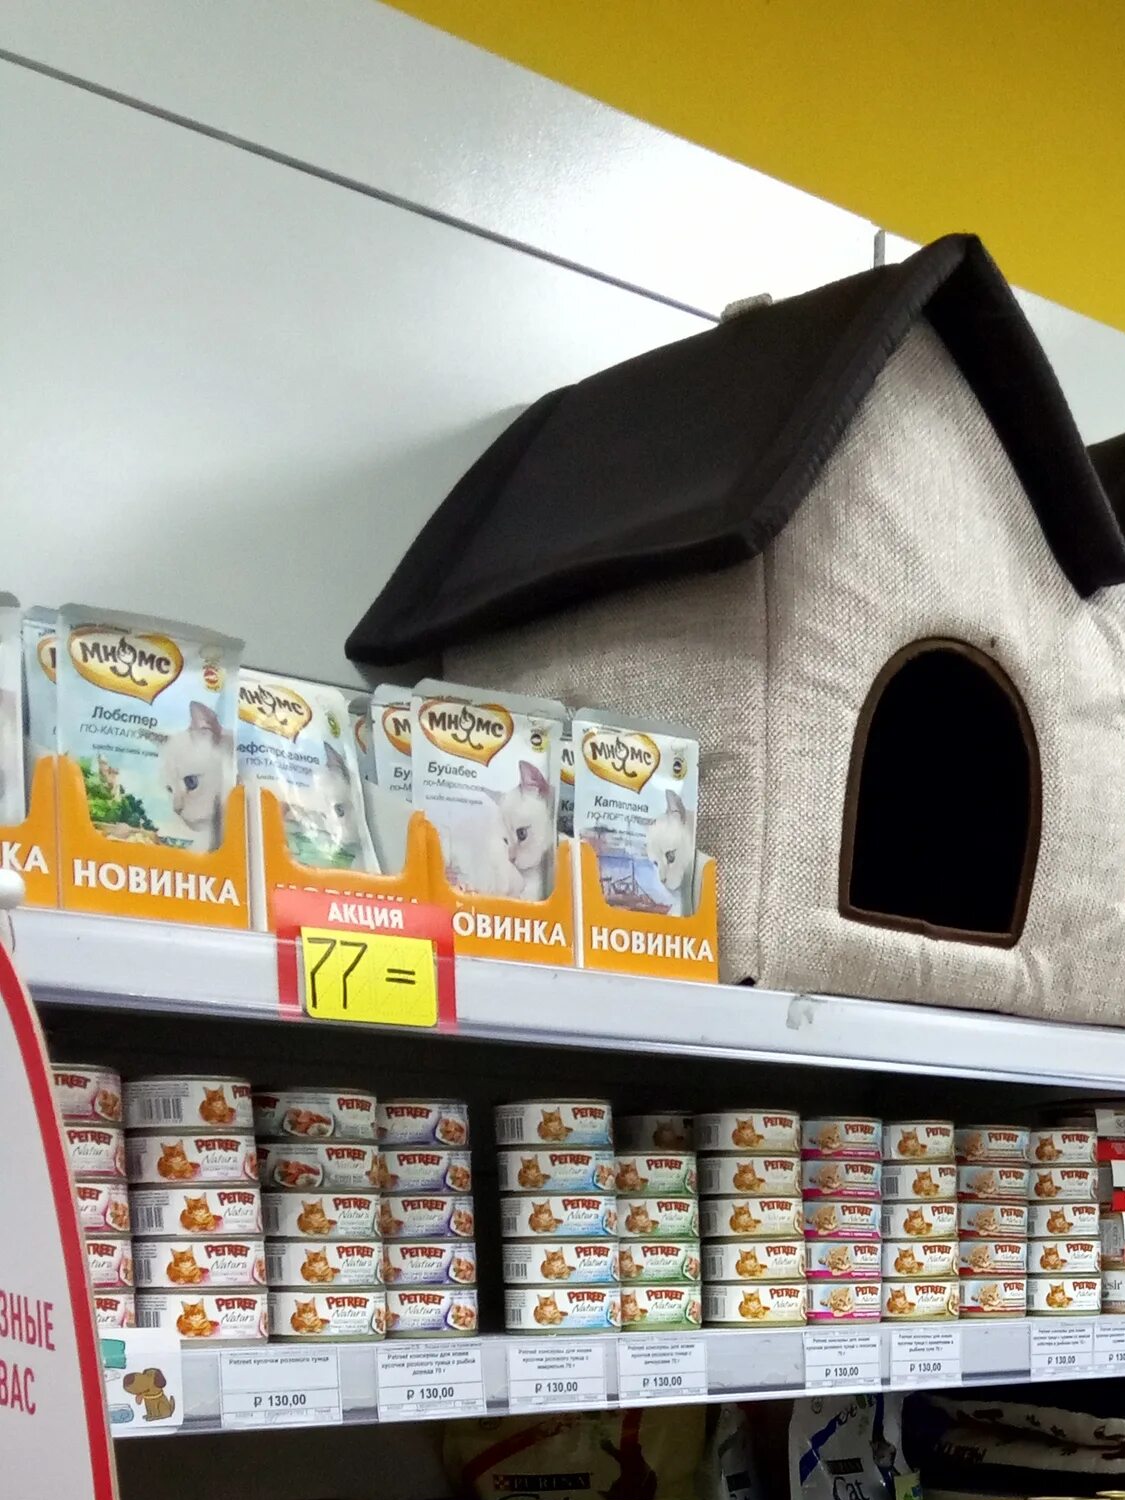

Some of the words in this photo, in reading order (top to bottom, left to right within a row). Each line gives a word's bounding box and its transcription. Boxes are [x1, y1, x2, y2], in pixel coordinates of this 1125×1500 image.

[92, 706, 158, 727] Лобстер
[427, 760, 478, 779] Буйабес
[72, 858, 241, 907] НОВИНКА
[327, 902, 404, 930] АКЦИЯ
[452, 911, 566, 948] ОВИНКА
[591, 926, 715, 963] НОВИНКА
[54, 1074, 91, 1089] TREET
[987, 1132, 1018, 1144] PETREET
[844, 1164, 875, 1176] PETREET
[841, 1205, 872, 1217] PETREET
[87, 1243, 117, 1257] TREET
[204, 1244, 250, 1258] PETREET
[400, 1247, 446, 1260] PETREET
[646, 1289, 685, 1302] PETREET
[914, 1285, 946, 1296] PETREET
[215, 1297, 257, 1312] PETREET
[326, 1297, 369, 1310] PETREET
[398, 1293, 444, 1306] PETREET
[834, 1366, 859, 1377] 130,00
[546, 1381, 578, 1393] 130,00
[653, 1376, 682, 1387] 130,00
[268, 1393, 306, 1407] 130,00
[419, 1386, 454, 1400] 130,00
